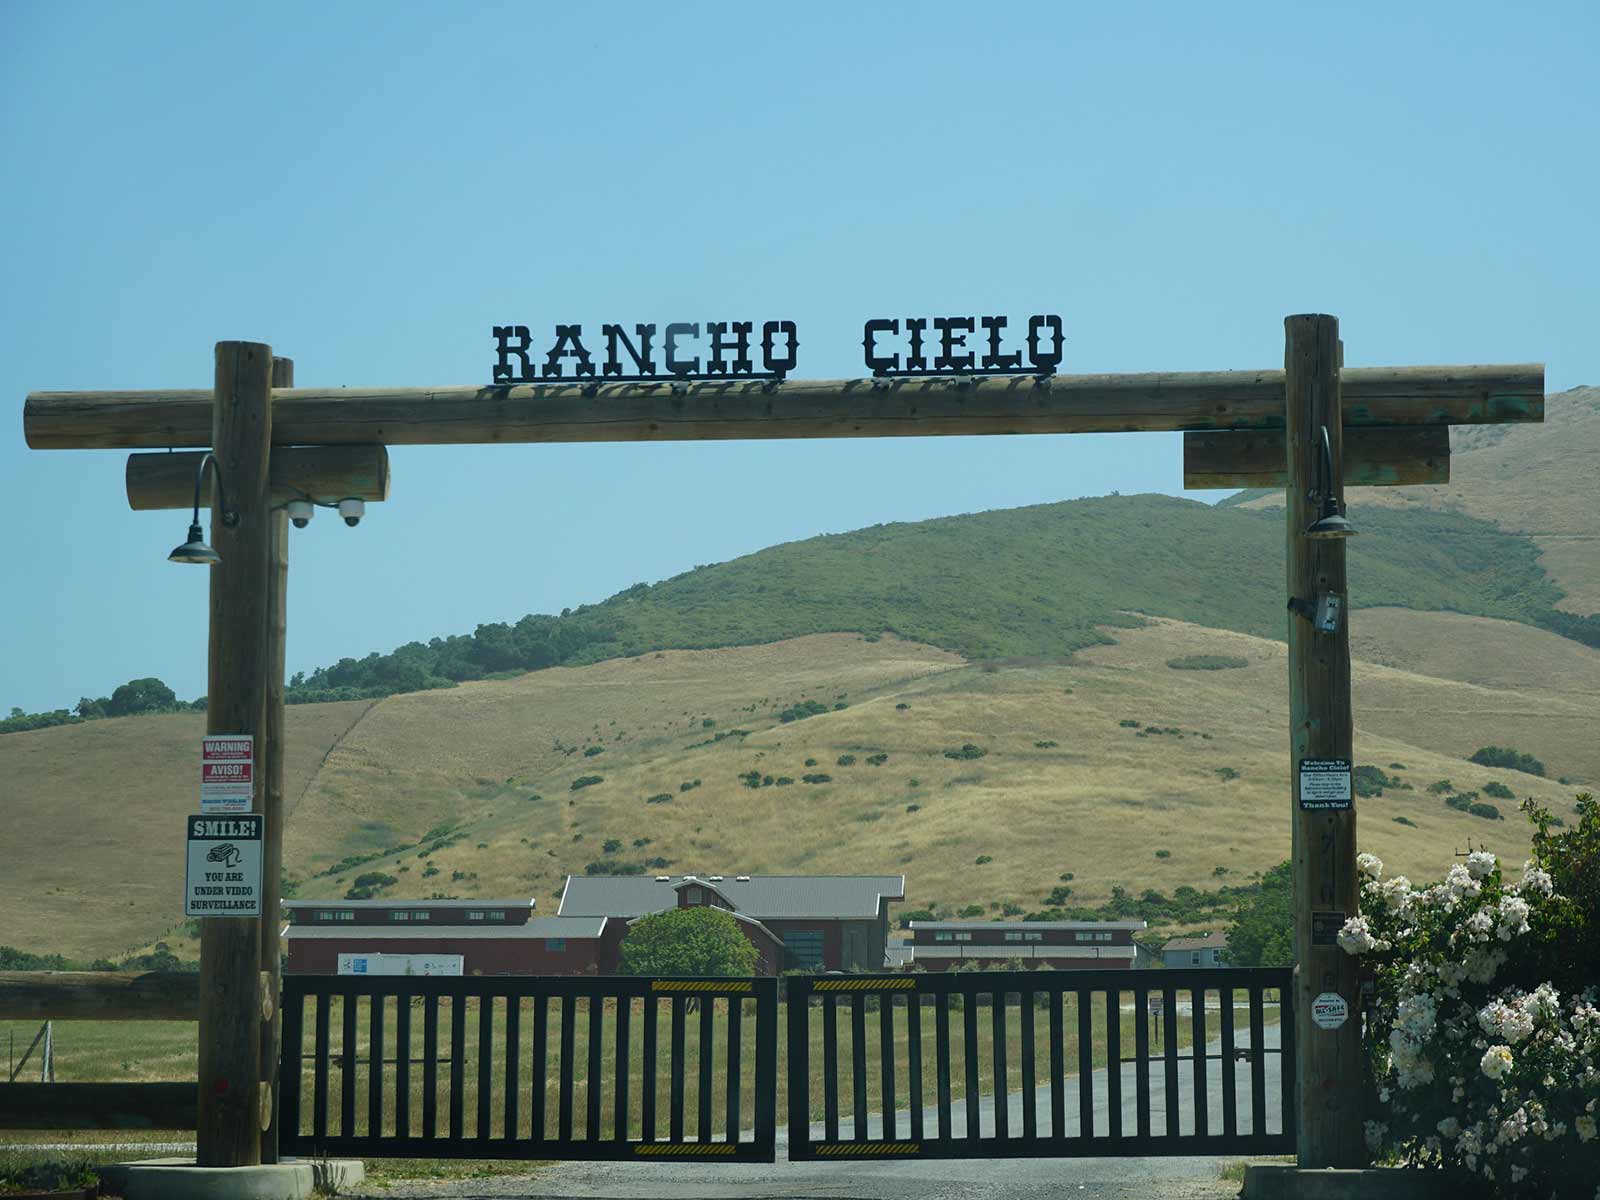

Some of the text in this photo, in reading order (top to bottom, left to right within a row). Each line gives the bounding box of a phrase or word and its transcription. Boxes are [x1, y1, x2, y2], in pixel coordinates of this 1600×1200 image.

[493, 315, 1066, 378] RANCHO CIELO
[205, 742, 250, 753] WARNING
[211, 765, 243, 775] AVISO!
[193, 820, 256, 836] SMILE!
[205, 872, 244, 882] YOU ARE
[194, 886, 253, 896] UNDER VIDEO
[190, 900, 256, 910] SURVEILLANCE
